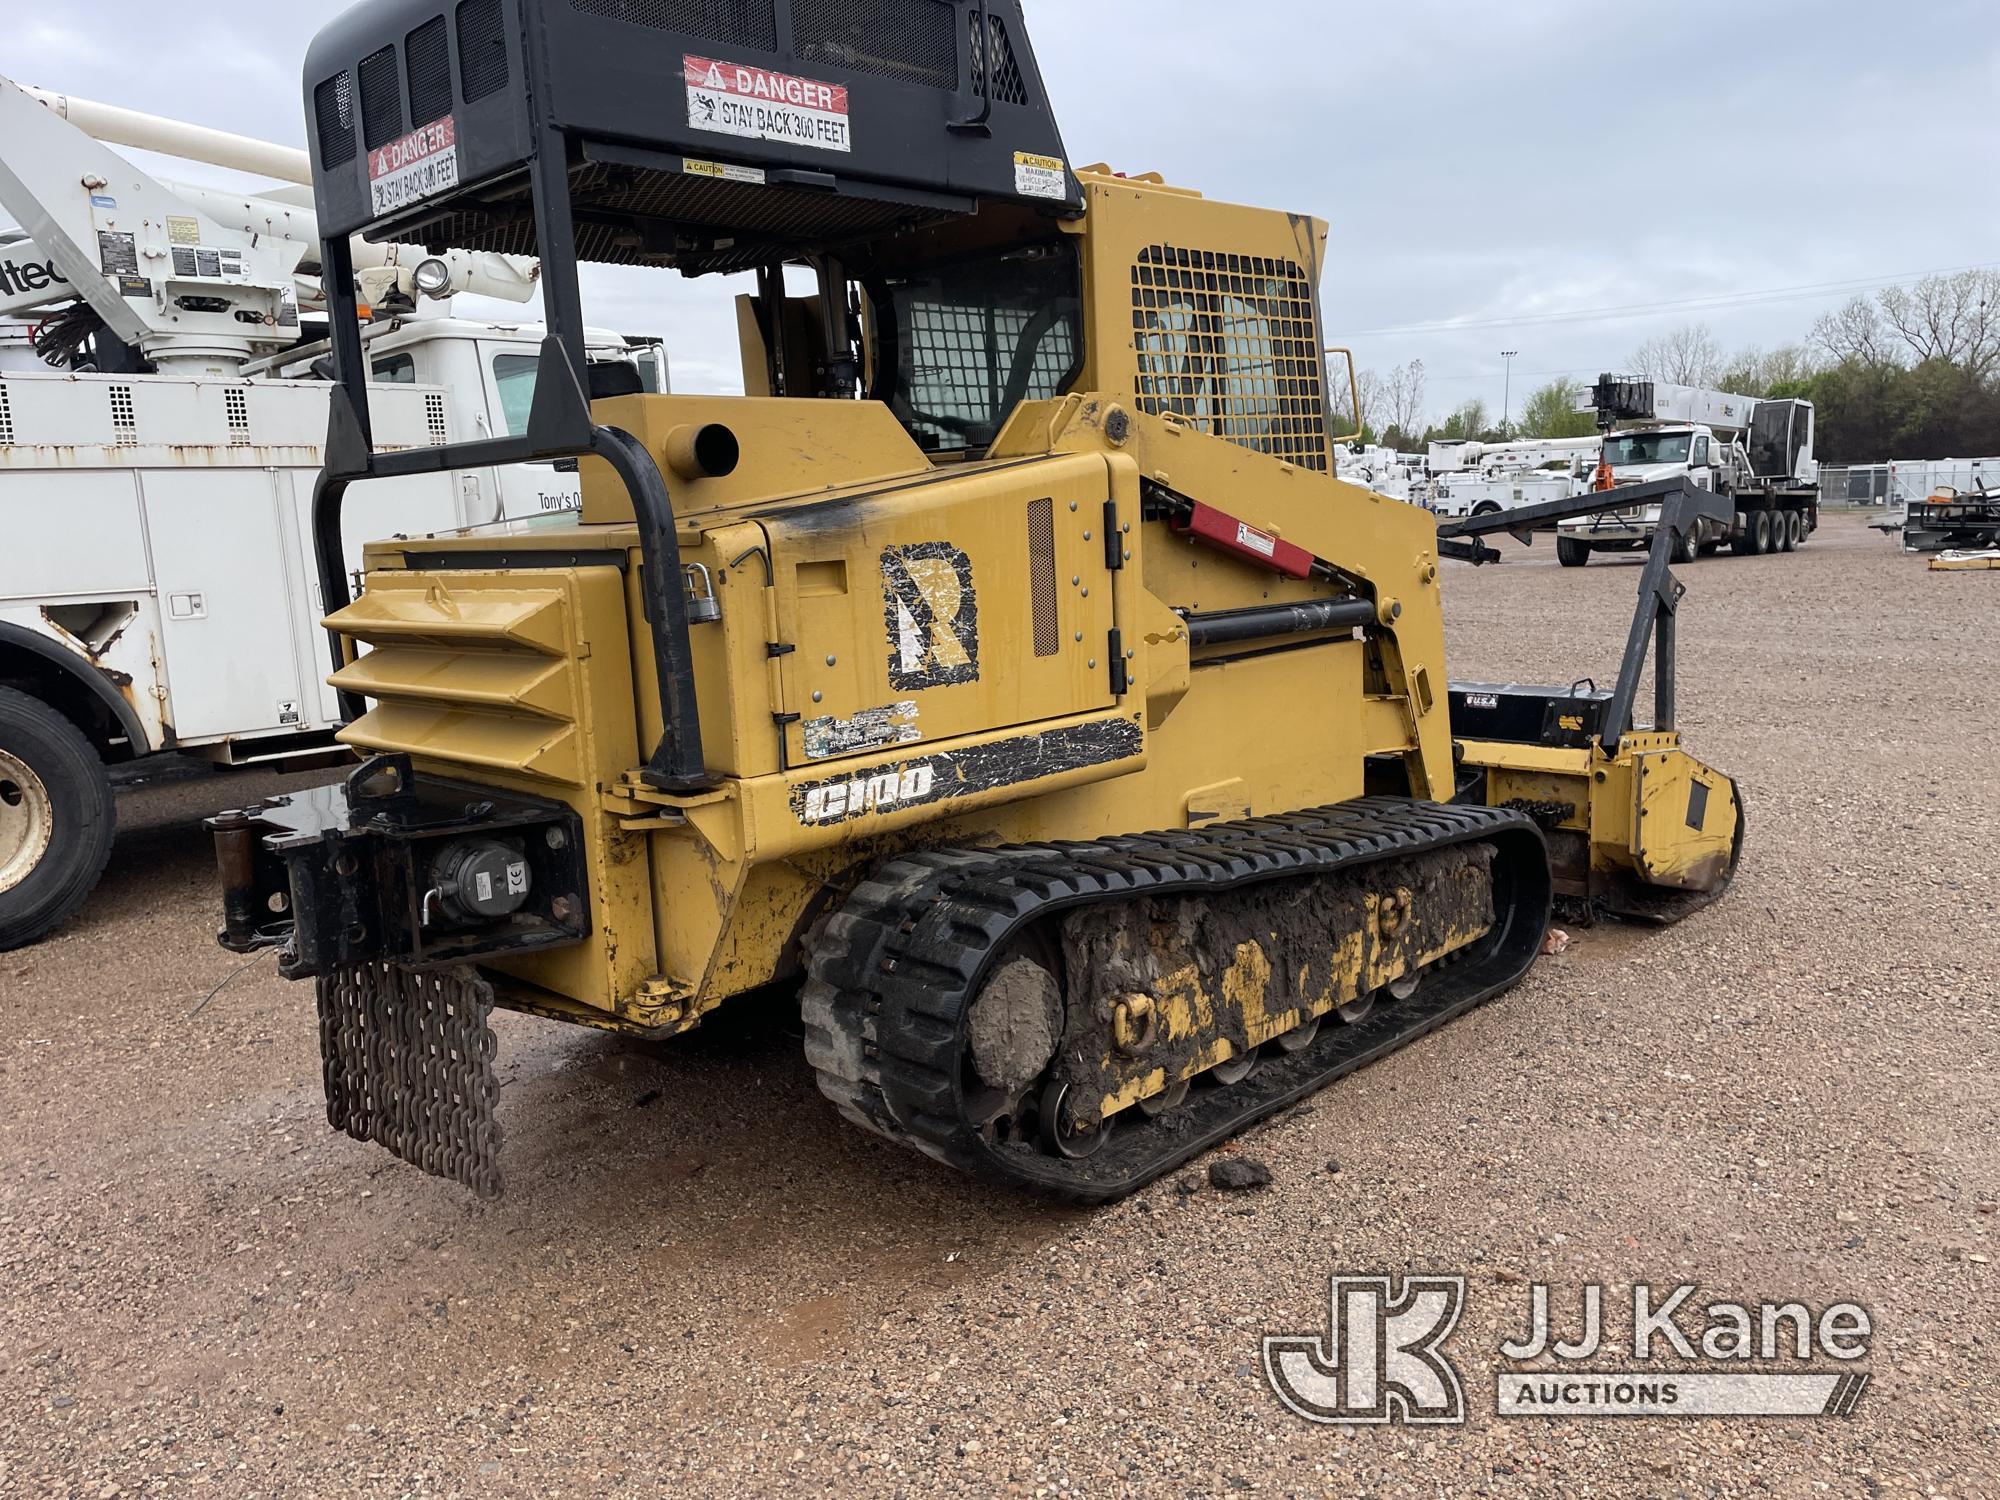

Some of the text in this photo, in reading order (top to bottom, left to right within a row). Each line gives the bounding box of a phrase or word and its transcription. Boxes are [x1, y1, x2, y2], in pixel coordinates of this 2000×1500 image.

[735, 69, 833, 110] DANGER
[722, 101, 845, 144] STAY BACK 300 FEET
[391, 123, 446, 168] DANGER
[693, 163, 723, 174] CAUTON
[1025, 167, 1053, 177] MAXIMUM
[1029, 157, 1057, 168] CAUTION
[387, 178, 404, 204] STAY
[404, 170, 425, 198] BACK
[436, 155, 455, 185] FEET
[537, 492, 572, 511] Tony's
